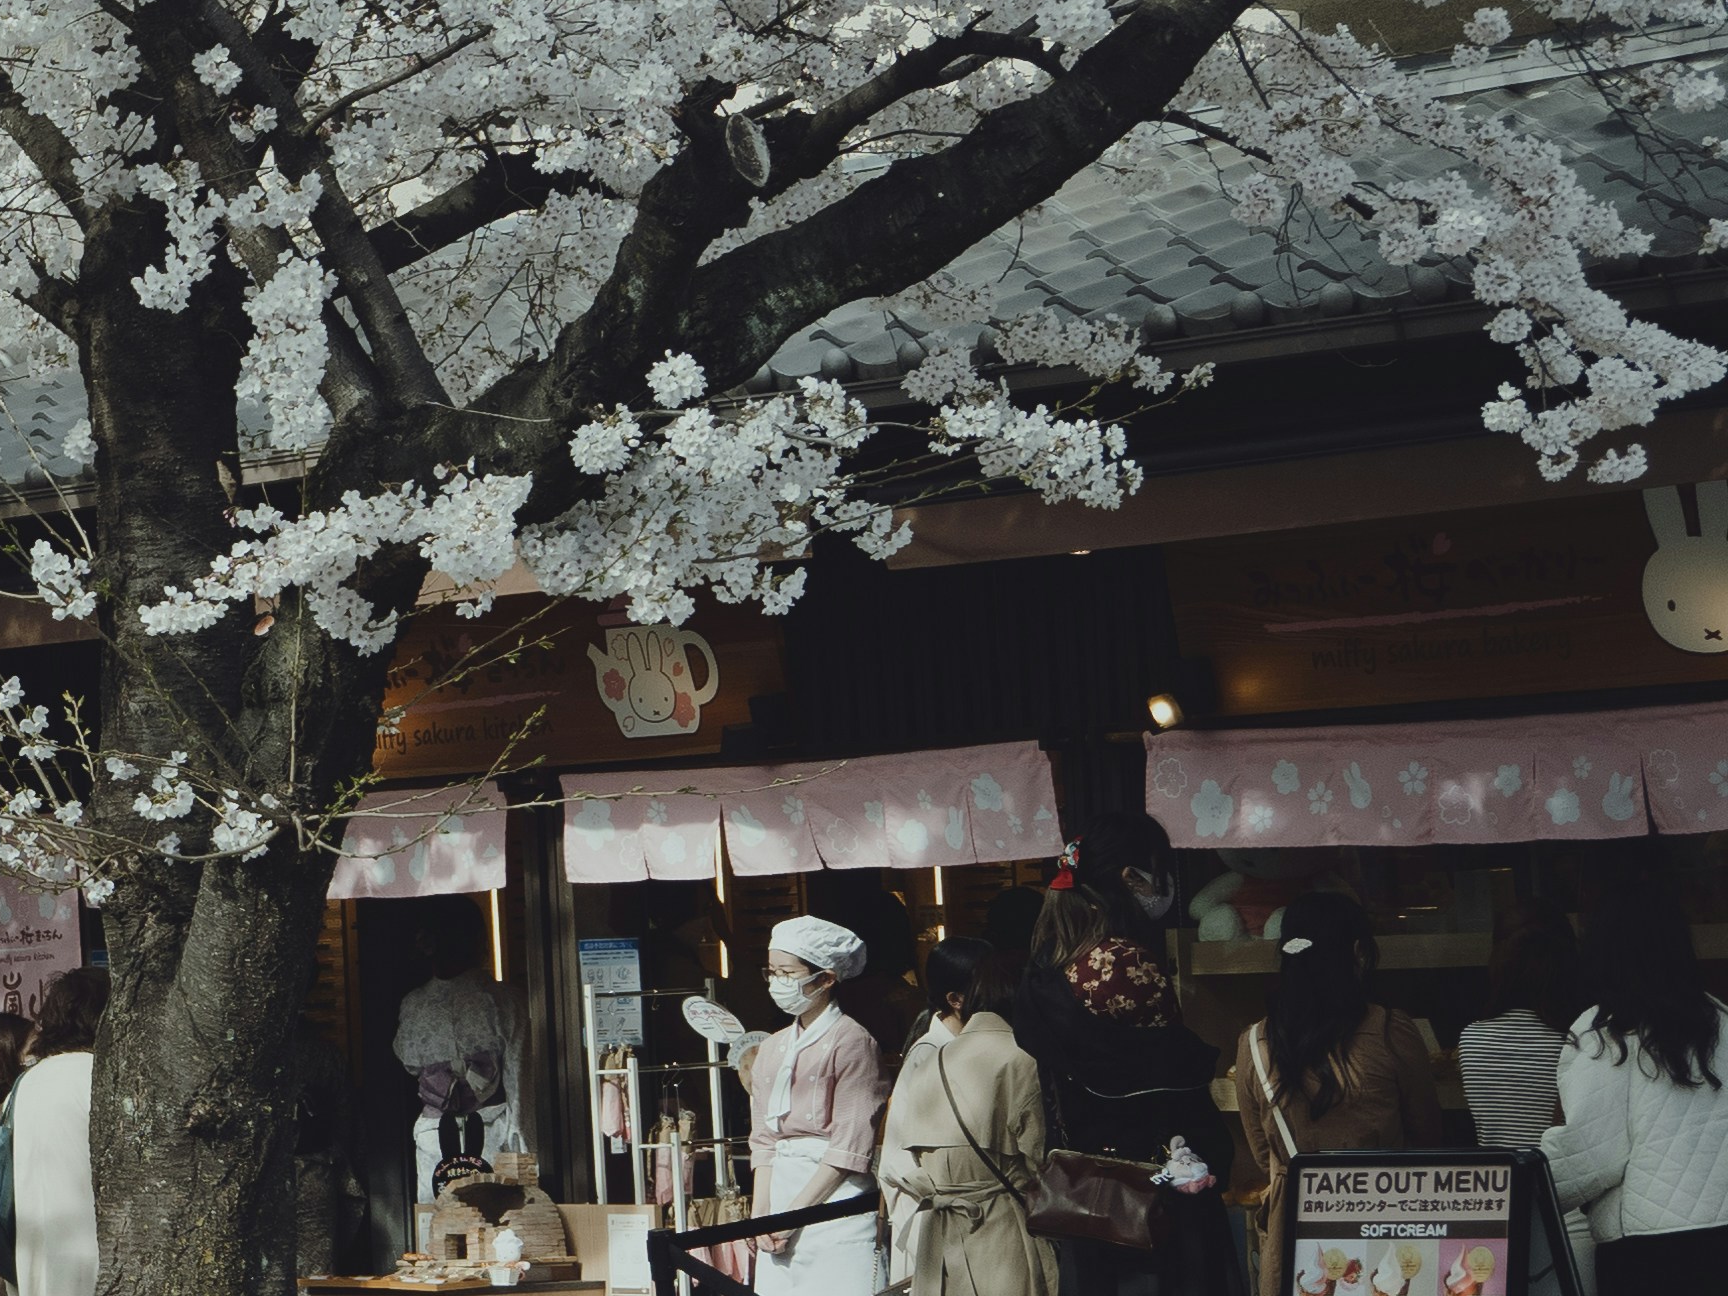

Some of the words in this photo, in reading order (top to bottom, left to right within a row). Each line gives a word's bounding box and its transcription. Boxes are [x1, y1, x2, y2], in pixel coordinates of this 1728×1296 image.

[1312, 637, 1376, 674] miffy
[1387, 633, 1473, 665] sakura
[1483, 625, 1572, 660] bakery
[376, 726, 407, 755] iffy
[413, 720, 476, 746] sakura
[1302, 1172, 1369, 1195] TAKE
[1375, 1171, 1428, 1194] OUT
[1433, 1170, 1509, 1194] MENU
[1303, 1198, 1506, 1213] 店内レジカウンターでご注文いただけます
[1360, 1223, 1448, 1237] SOFTCREAM
